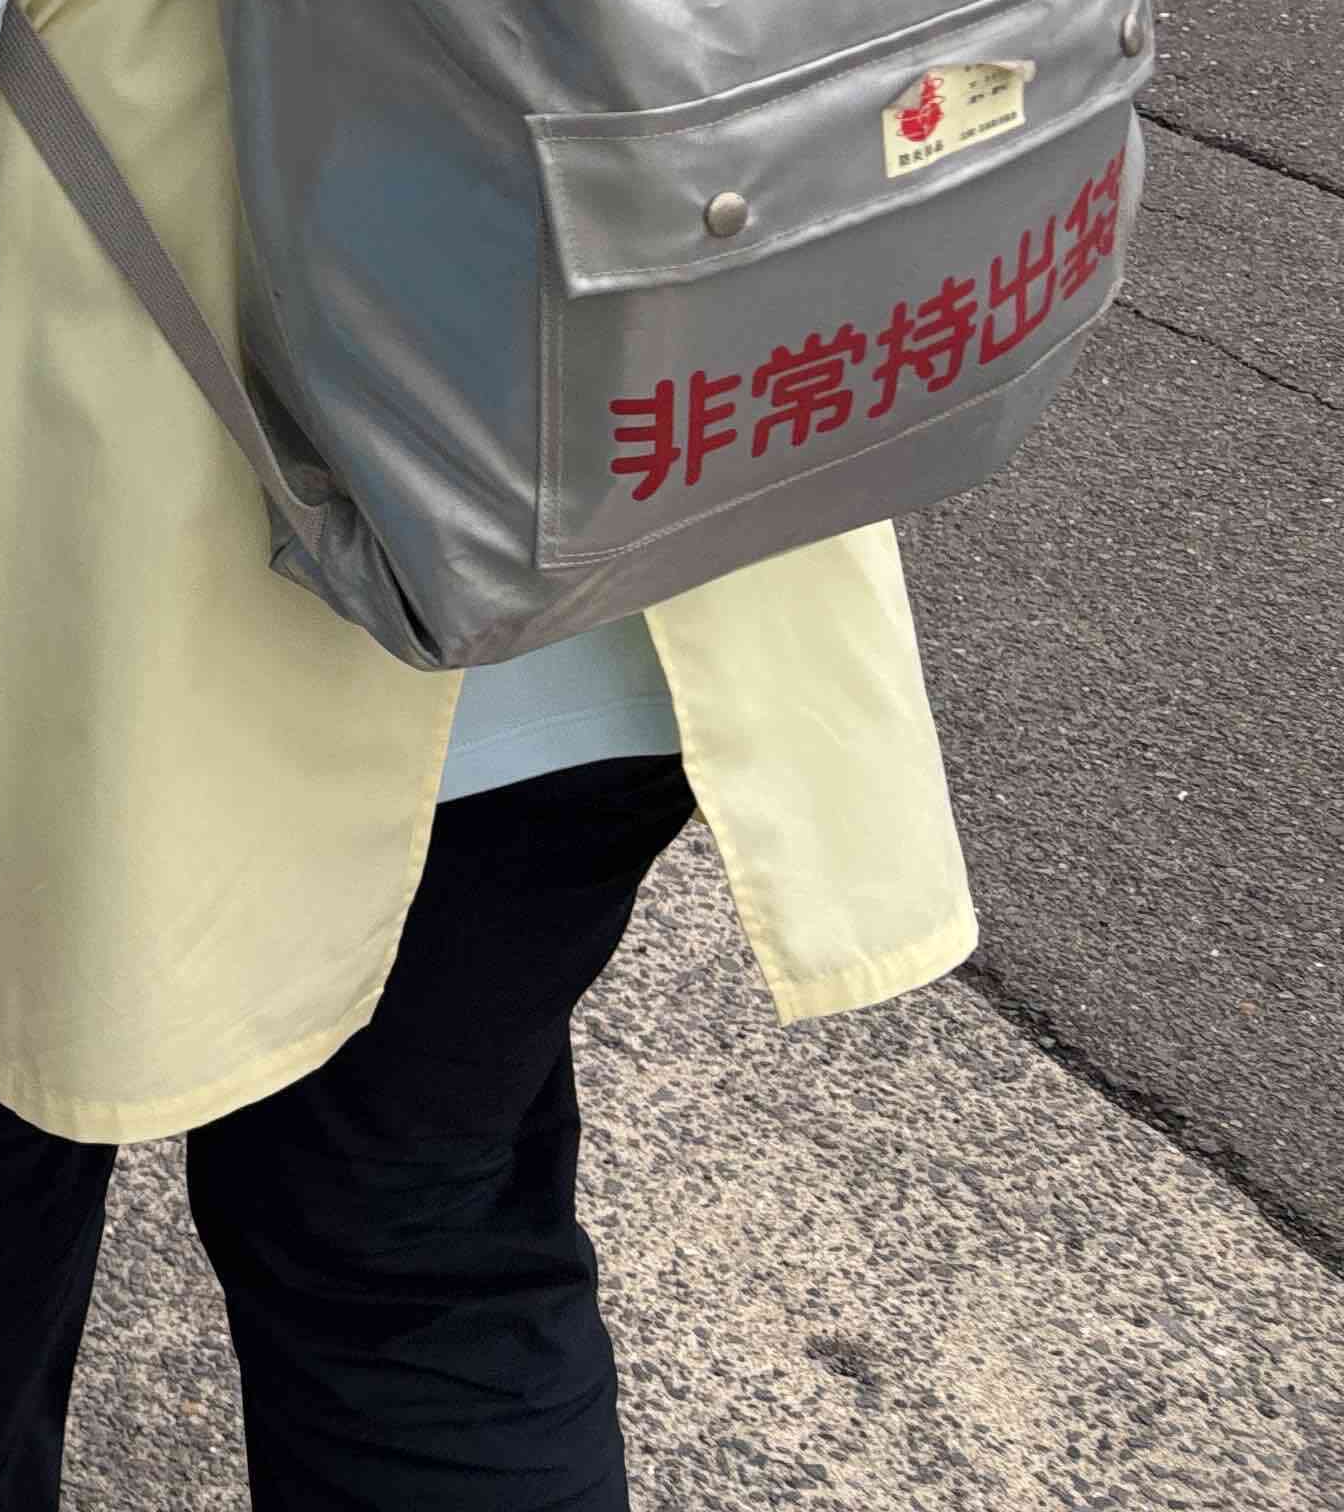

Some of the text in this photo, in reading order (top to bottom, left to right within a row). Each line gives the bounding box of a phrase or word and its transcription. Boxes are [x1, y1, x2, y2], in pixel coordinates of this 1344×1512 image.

[608, 143, 1125, 502] 非常持出袋
